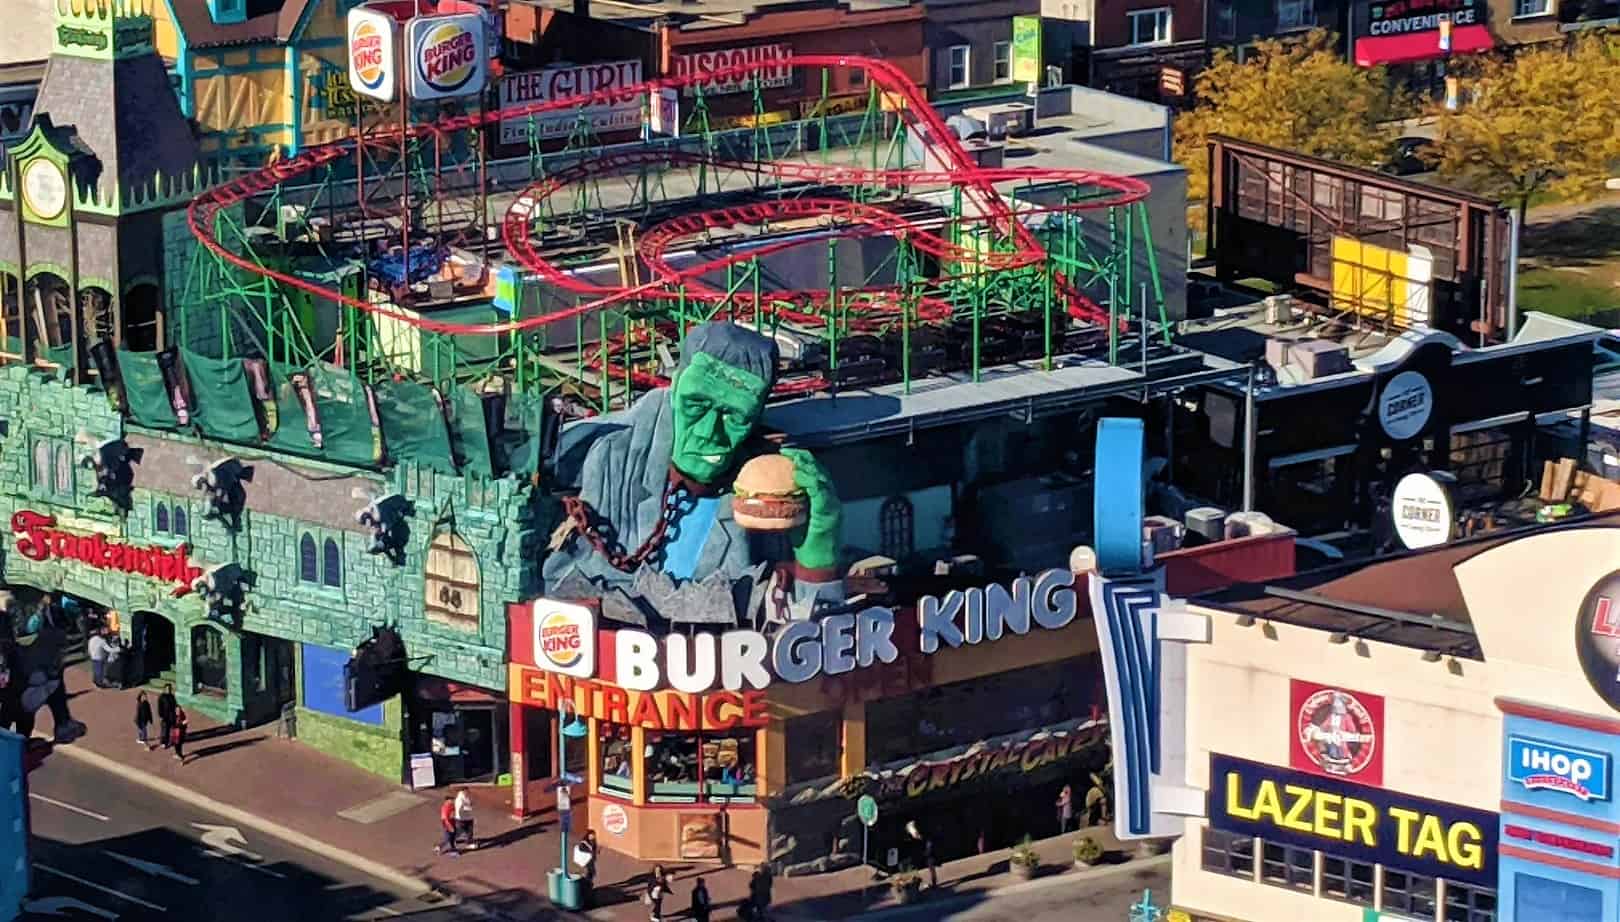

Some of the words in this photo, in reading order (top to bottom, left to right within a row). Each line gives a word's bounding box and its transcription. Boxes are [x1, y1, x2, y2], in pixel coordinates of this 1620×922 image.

[424, 31, 473, 63] BURGER
[427, 44, 475, 82] KING
[672, 43, 793, 87] DISCOUNT
[503, 73, 544, 102] THE
[550, 62, 639, 107] GURU
[541, 623, 578, 639] BURGER
[543, 634, 581, 653] KING
[616, 605, 899, 694] BURGER
[918, 567, 1078, 655] KING
[521, 666, 770, 730] ENTRANCE
[907, 743, 1020, 797] CRYSTAL
[1521, 747, 1592, 783] IHOP
[1226, 772, 1377, 847] LAZER
[1388, 805, 1483, 869] TAG
